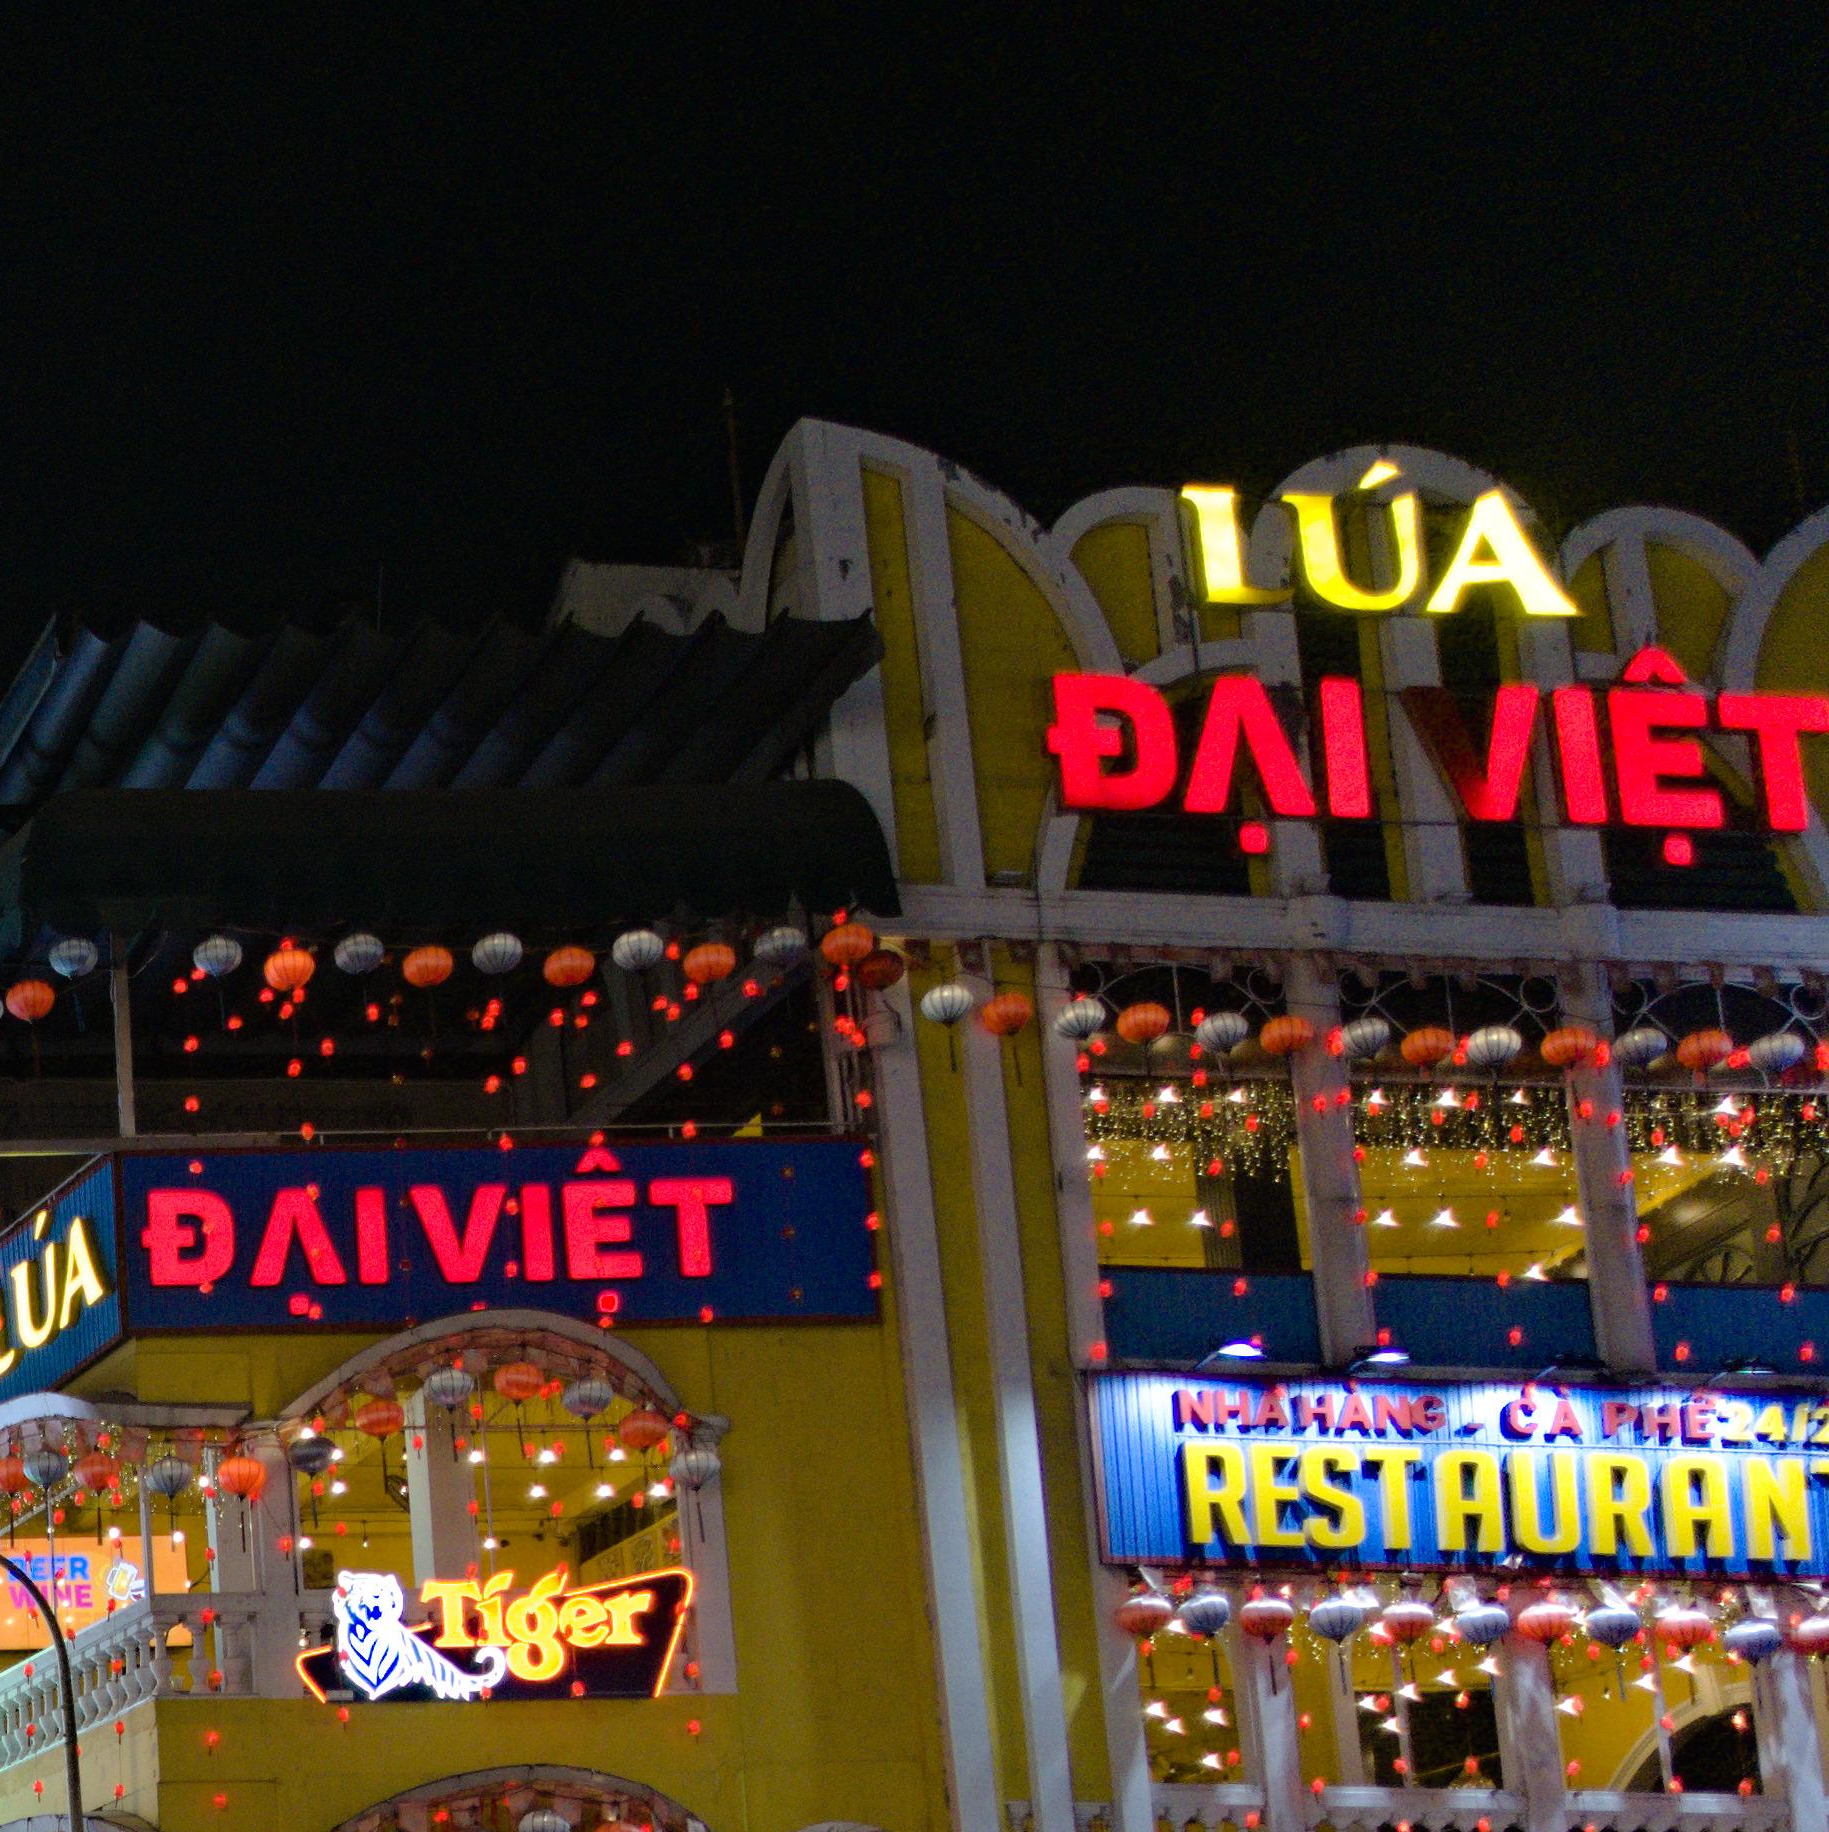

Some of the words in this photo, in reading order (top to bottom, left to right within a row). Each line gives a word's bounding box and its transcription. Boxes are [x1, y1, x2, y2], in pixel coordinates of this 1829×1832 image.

[1181, 461, 1581, 617] LÚA
[1045, 672, 1373, 856] ĐẠI
[1397, 646, 1829, 866] VIỆT
[142, 1184, 391, 1315] ĐẠI
[409, 1147, 733, 1314] VIỆT
[1304, 1384, 1447, 1432] HÀNG
[8, 1556, 91, 1583] BEER
[8, 1583, 94, 1610] WINE
[421, 1568, 651, 1682] Tiger
